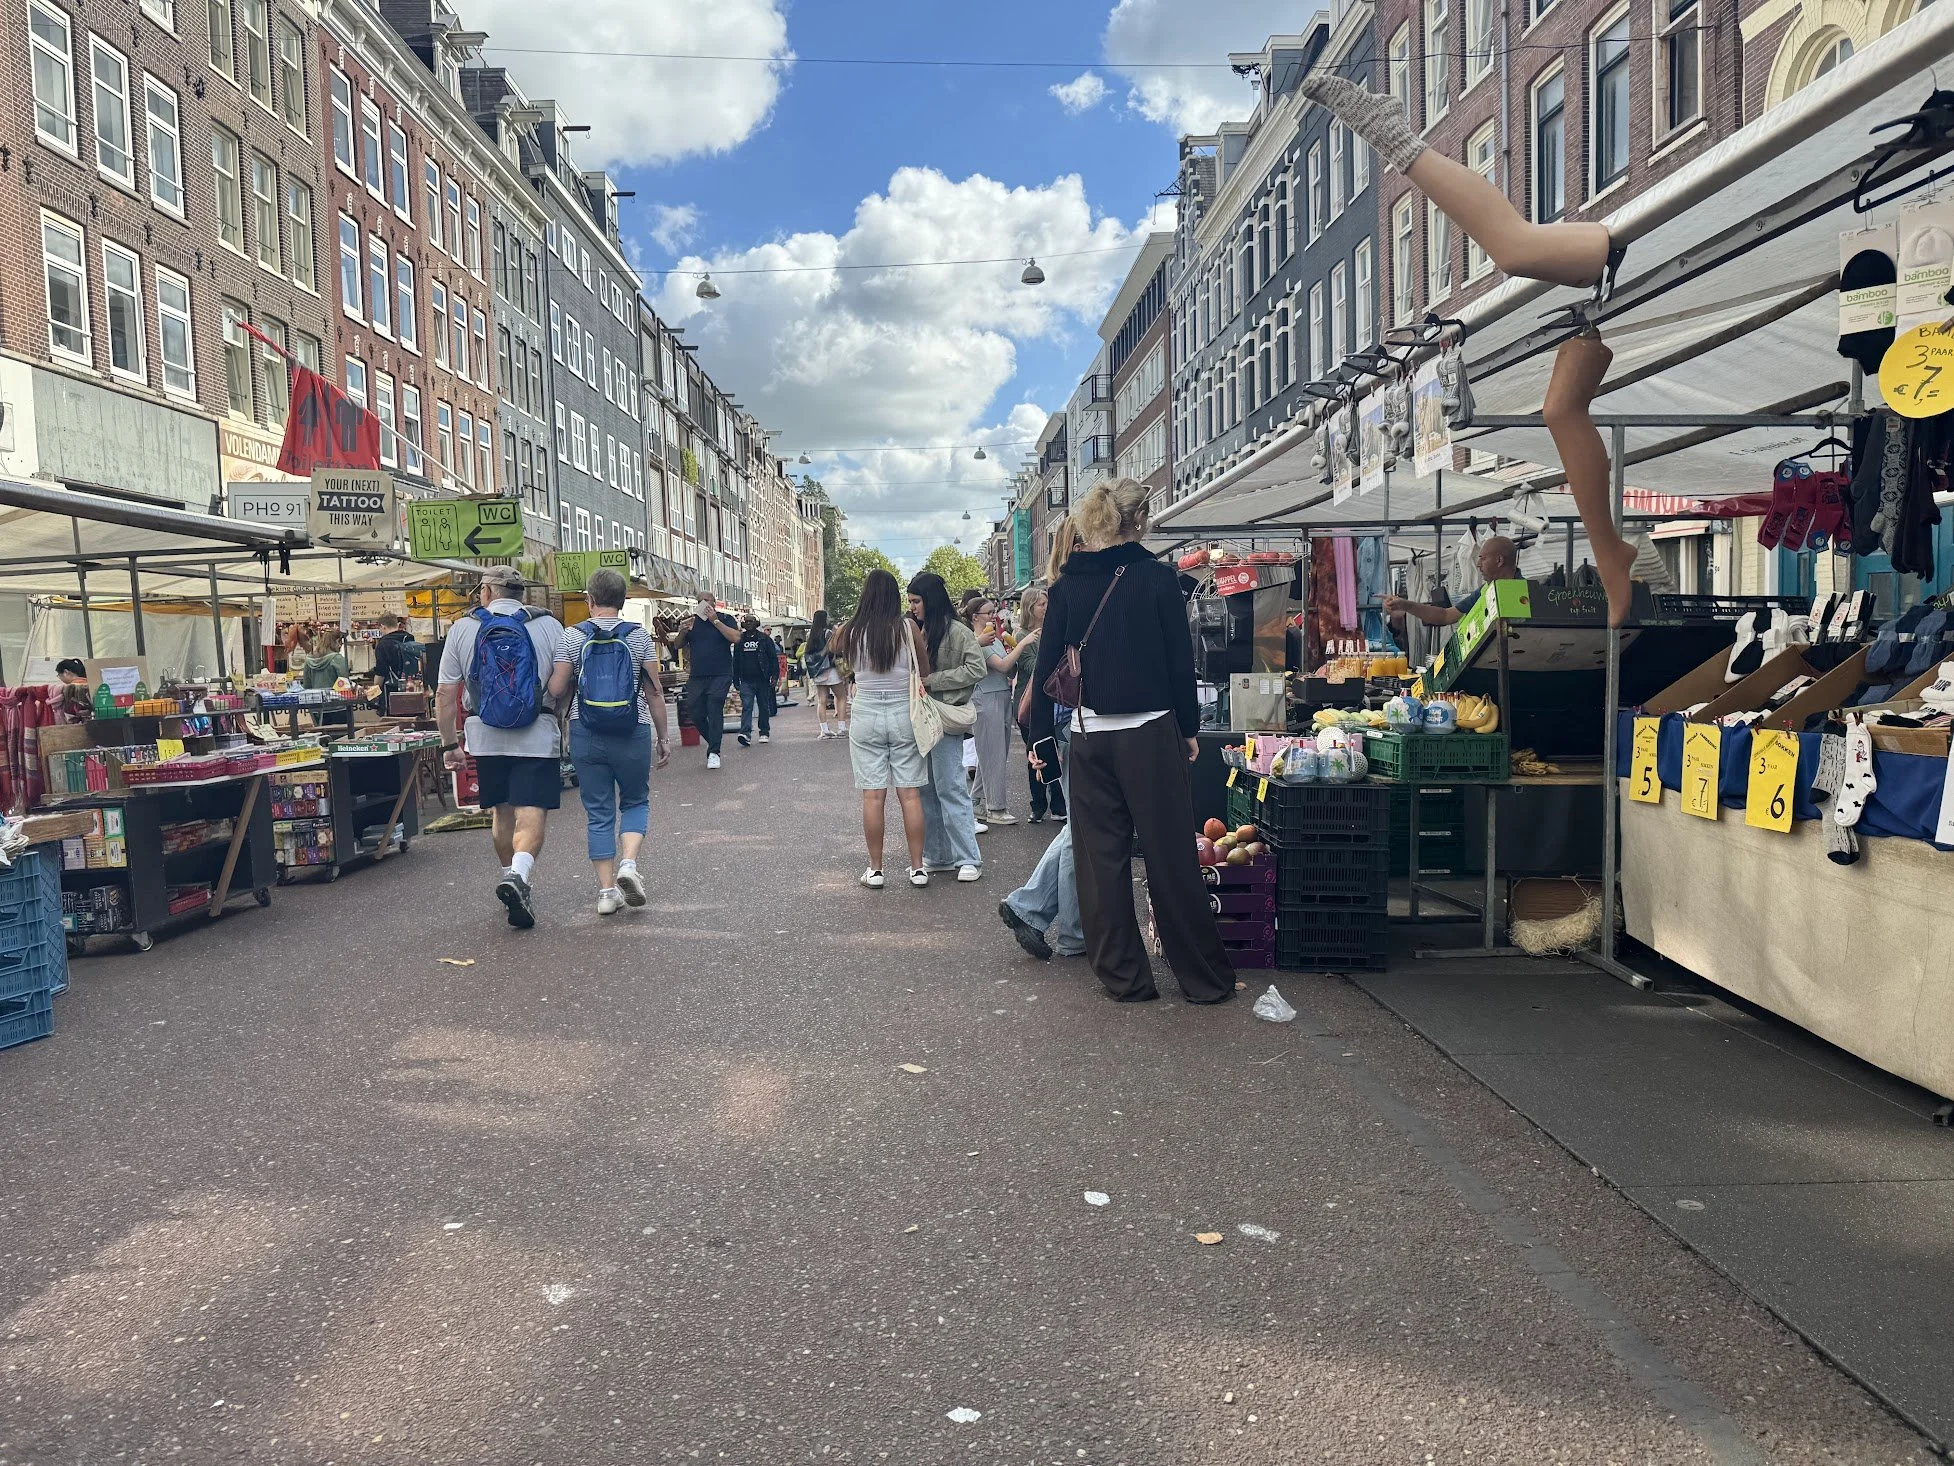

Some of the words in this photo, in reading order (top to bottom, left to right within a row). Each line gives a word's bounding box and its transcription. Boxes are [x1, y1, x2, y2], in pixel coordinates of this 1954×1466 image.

[1904, 268, 1949, 281] bamboo
[1846, 289, 1888, 302] bamboo
[1919, 327, 1954, 339] BA
[1906, 345, 1929, 368] 3
[1931, 347, 1953, 356] PAAR
[324, 478, 349, 490] YOUR
[351, 480, 380, 492] (NEXT)
[320, 495, 381, 510] TATTOO
[286, 503, 301, 516] 91
[482, 506, 511, 521] WC
[329, 513, 350, 525] THIS
[352, 514, 374, 527] WAY
[603, 553, 624, 564] WC
[338, 744, 370, 752] Heineken
[1635, 746, 1641, 758] 3
[1686, 754, 1692, 767] 3
[1758, 757, 1766, 774] 3
